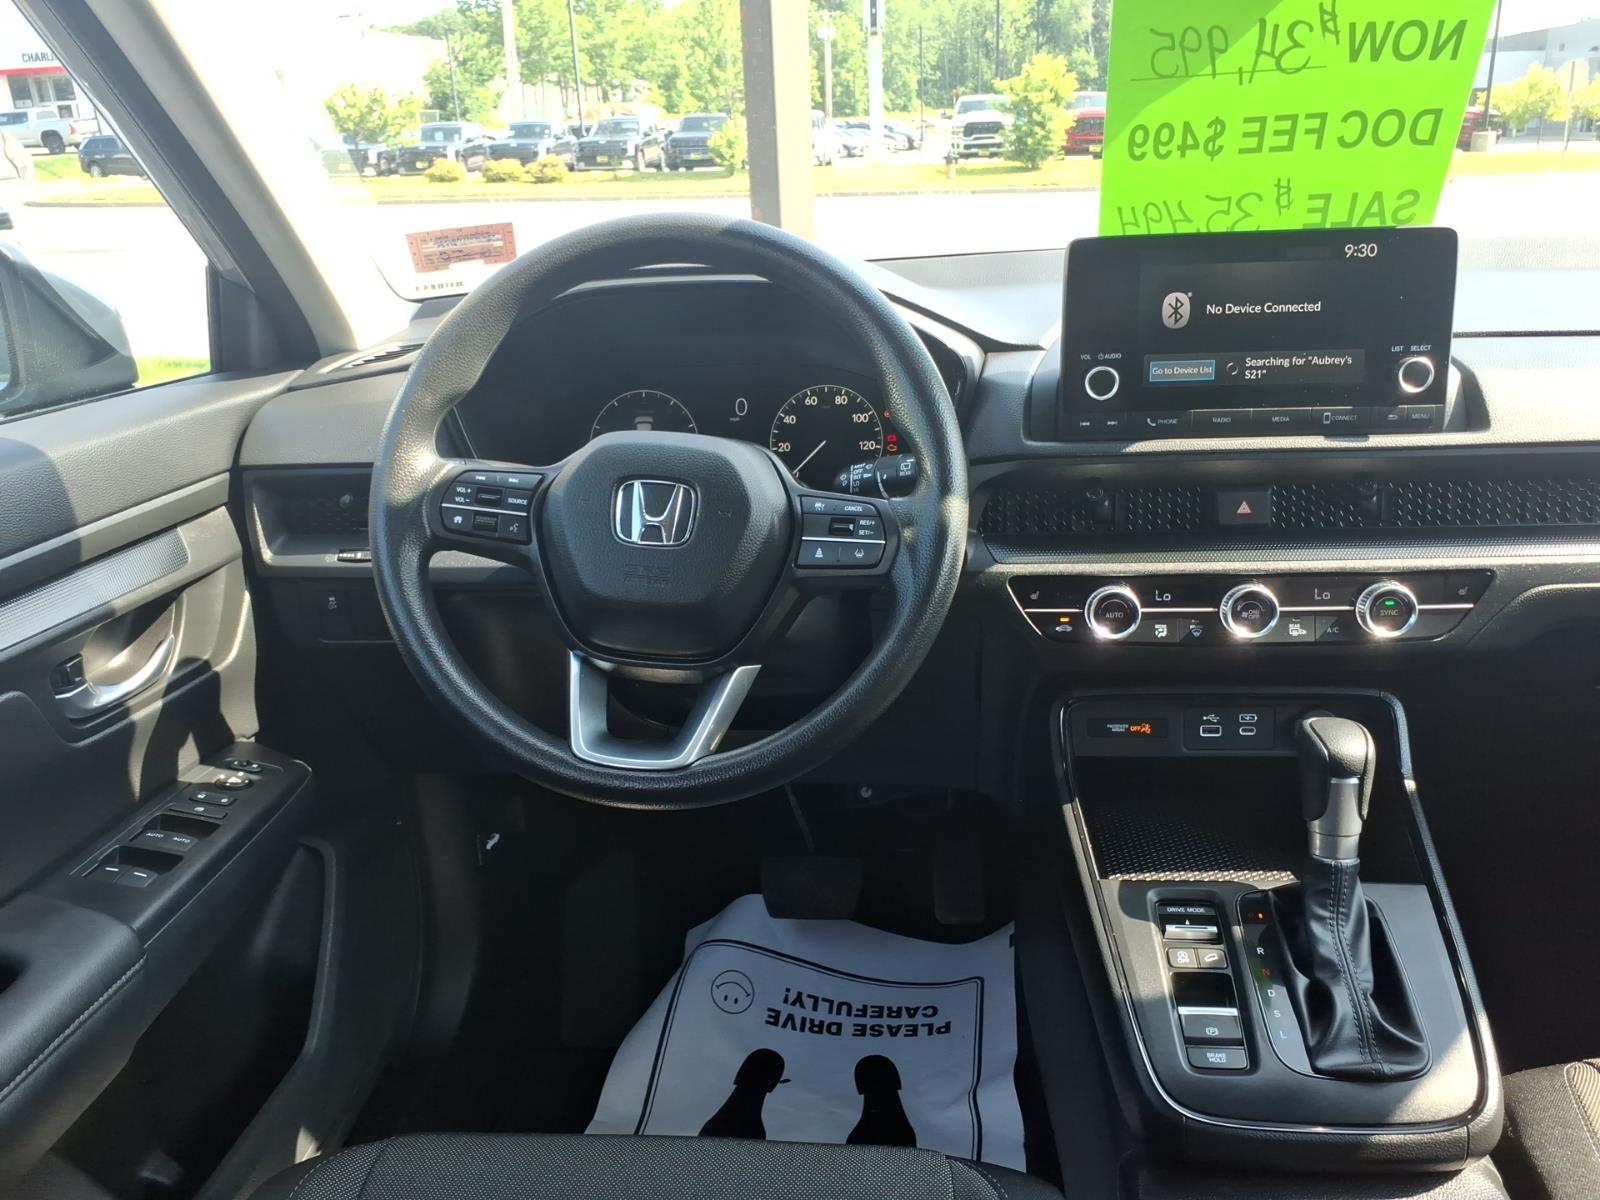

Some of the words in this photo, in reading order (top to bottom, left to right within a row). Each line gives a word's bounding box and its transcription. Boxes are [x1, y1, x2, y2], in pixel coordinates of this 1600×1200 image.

[22, 52, 56, 62] CHARLI
[1344, 243, 1377, 258] 9:30
[1206, 304, 1223, 315] No
[1225, 303, 1261, 314] Device
[1264, 301, 1322, 313] Connected
[1245, 356, 1290, 369] Searching
[1292, 356, 1306, 365] for
[1308, 354, 1353, 367] "Aubrey's
[1152, 367, 1163, 376] Go
[1164, 367, 1173, 375] to
[1173, 366, 1199, 375] Device
[1199, 365, 1213, 375] List
[1244, 368, 1267, 379] S21"
[804, 395, 818, 406] 60
[834, 395, 848, 405] 80
[735, 397, 748, 416] 0
[783, 415, 797, 425] 40
[851, 413, 869, 423] 100
[778, 443, 791, 452] 20
[859, 440, 876, 450] 120
[507, 497, 528, 505] SOURCE
[1155, 589, 1171, 601] Lo
[1314, 588, 1331, 600] Lo
[1257, 947, 1265, 955] R
[1263, 968, 1271, 976] N
[1267, 989, 1276, 998] D
[783, 987, 939, 1019] CAREFULLY!
[1273, 1010, 1281, 1018] S
[765, 1007, 843, 1036] DRIVE
[851, 1021, 952, 1038] PLEASE
[1280, 1031, 1288, 1039] L
